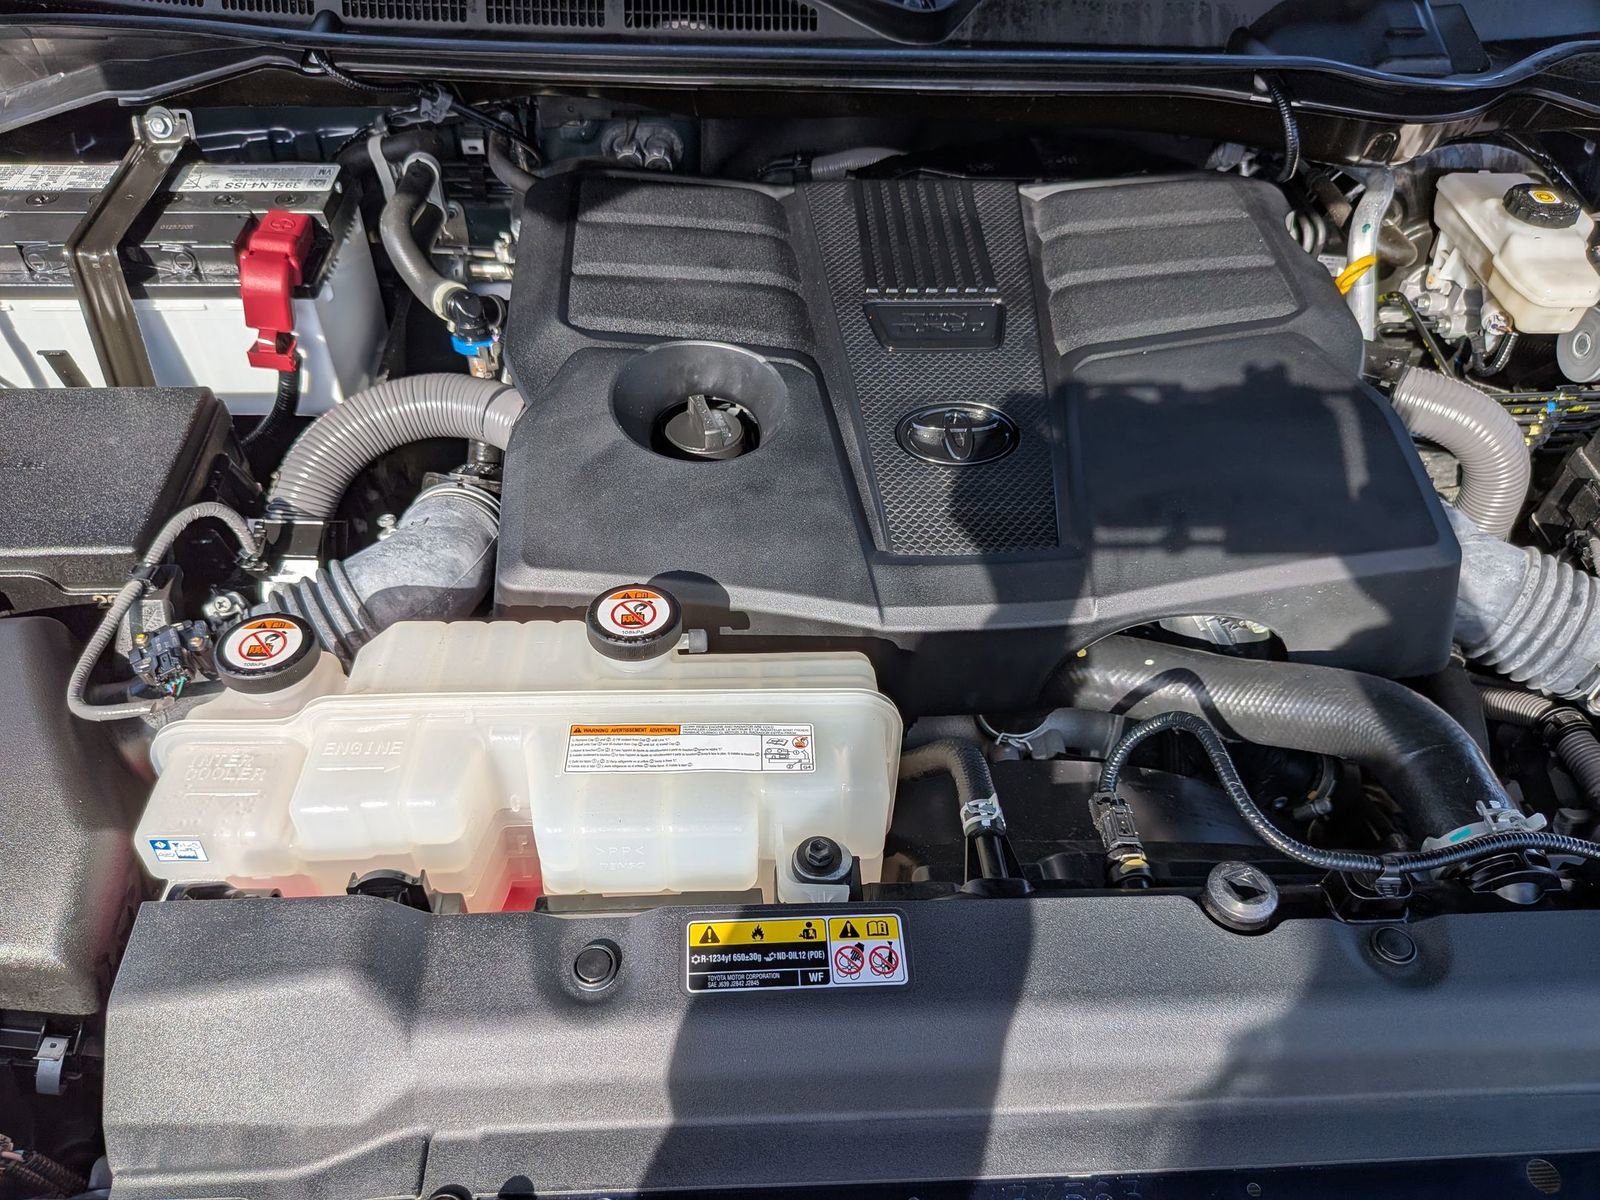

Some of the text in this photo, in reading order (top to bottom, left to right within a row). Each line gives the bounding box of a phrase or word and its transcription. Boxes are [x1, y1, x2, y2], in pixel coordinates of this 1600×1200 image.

[321, 740, 404, 756] ENGINE
[701, 954, 731, 963] R-1234yf
[733, 953, 762, 962] 650±30g
[807, 950, 825, 960] (POE)
[809, 972, 824, 982] WF
